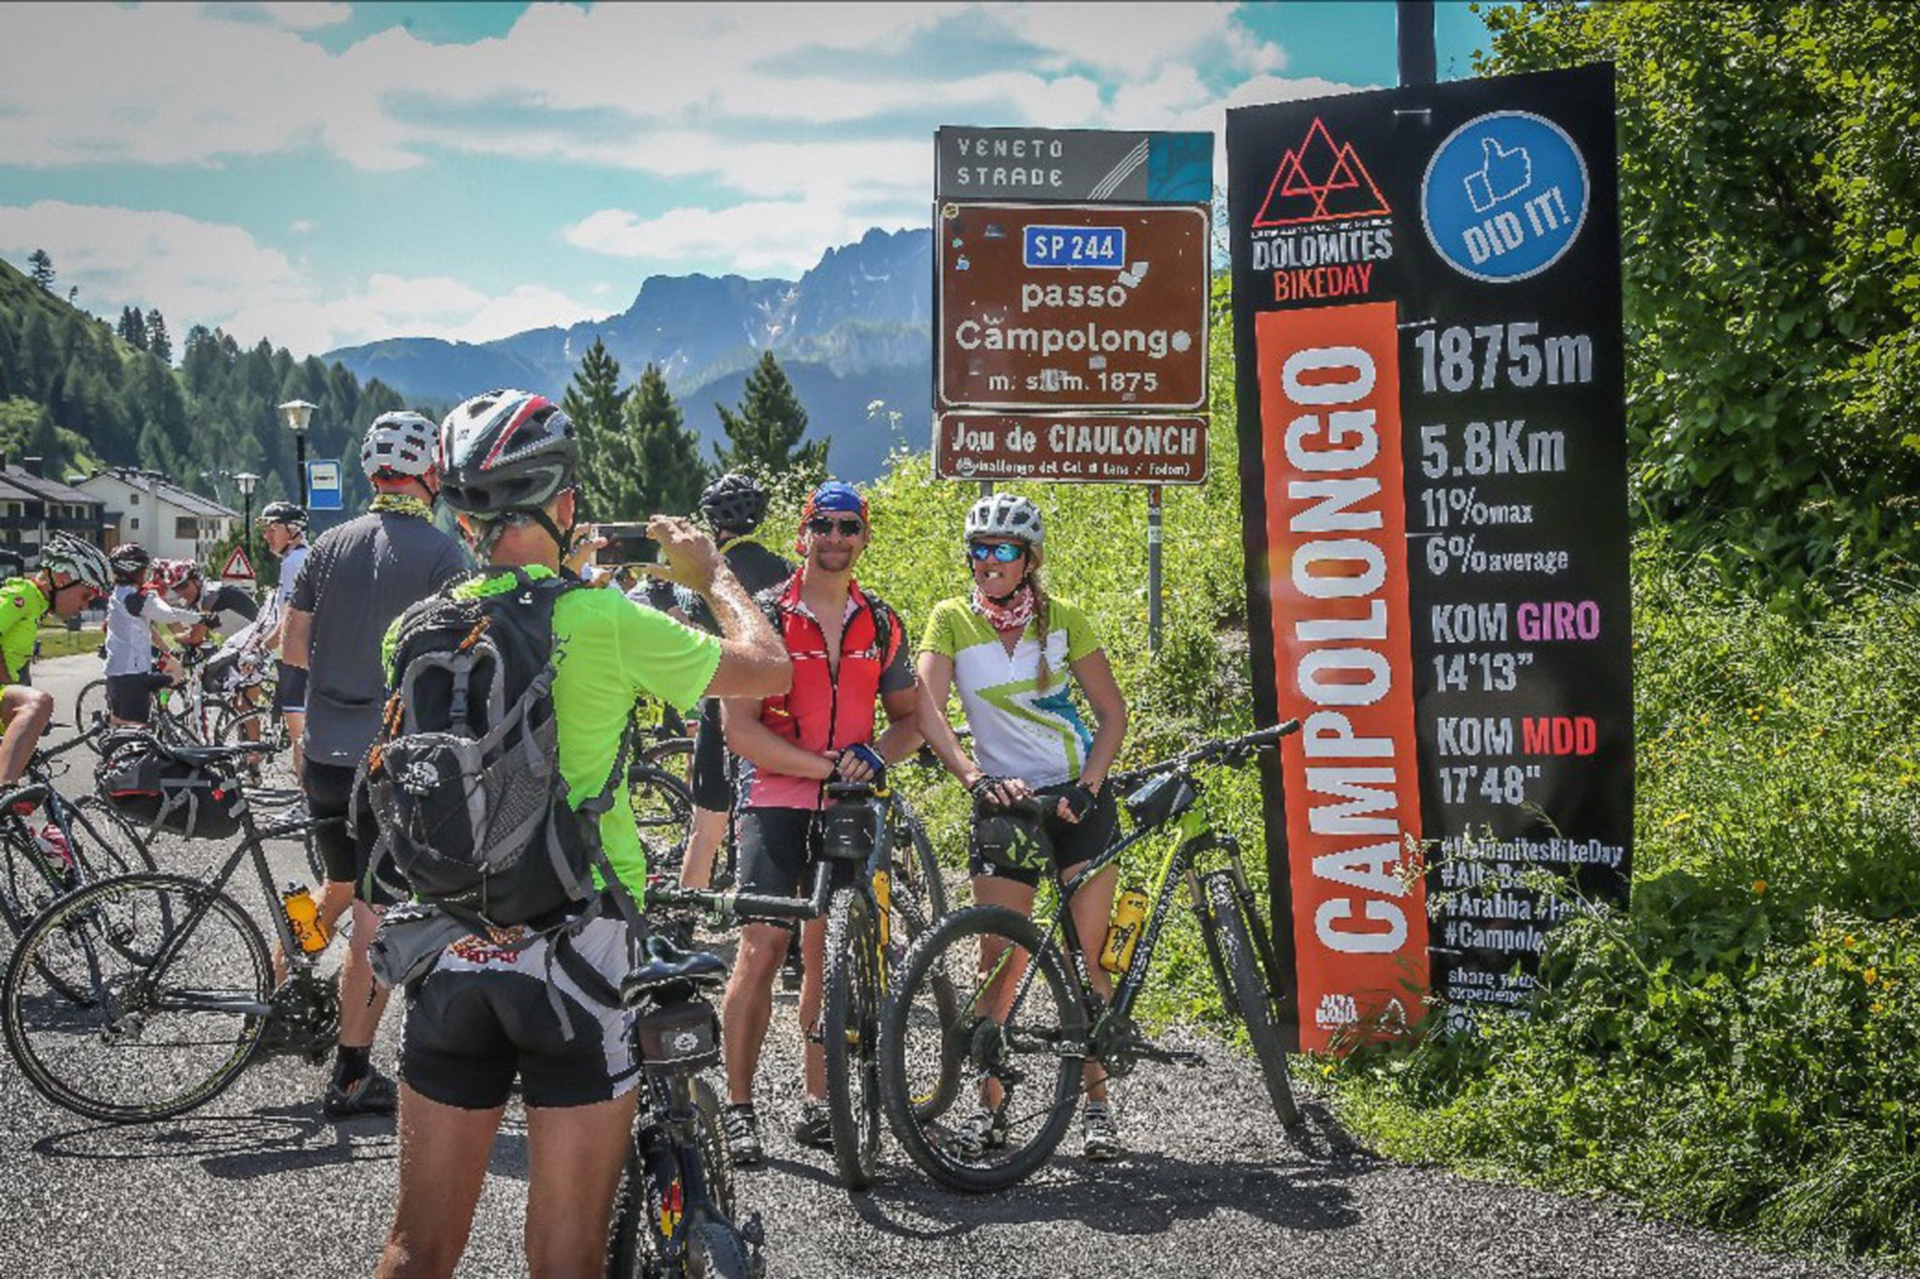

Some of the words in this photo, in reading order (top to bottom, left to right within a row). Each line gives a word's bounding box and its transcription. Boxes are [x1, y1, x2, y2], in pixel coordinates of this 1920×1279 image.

[958, 138, 1064, 158] VENETO
[958, 167, 1064, 187] STRADE
[1462, 212, 1524, 265] DID
[1524, 186, 1571, 237] IT!
[1034, 235, 1064, 259] SP
[1071, 236, 1115, 260] 244
[1252, 228, 1393, 270] DOLOMITES
[1022, 283, 1127, 312] passo
[1273, 263, 1373, 301] BIKEDAY
[1415, 321, 1594, 393] 1875m
[1098, 371, 1159, 392] 1875
[952, 422, 995, 451] Jou
[1005, 424, 1037, 453] de
[1048, 424, 1197, 455] CIAULONCH
[1420, 420, 1567, 479] 5.8Km
[1039, 461, 1058, 474] del
[1432, 603, 1508, 643] KOM
[1516, 600, 1600, 642] GIRO
[1280, 346, 1408, 954] CAMPOLONGO
[1437, 716, 1513, 756] KOM
[1522, 715, 1597, 756] MDD
[1445, 892, 1531, 921] #Arabba
[1448, 967, 1494, 985] share
